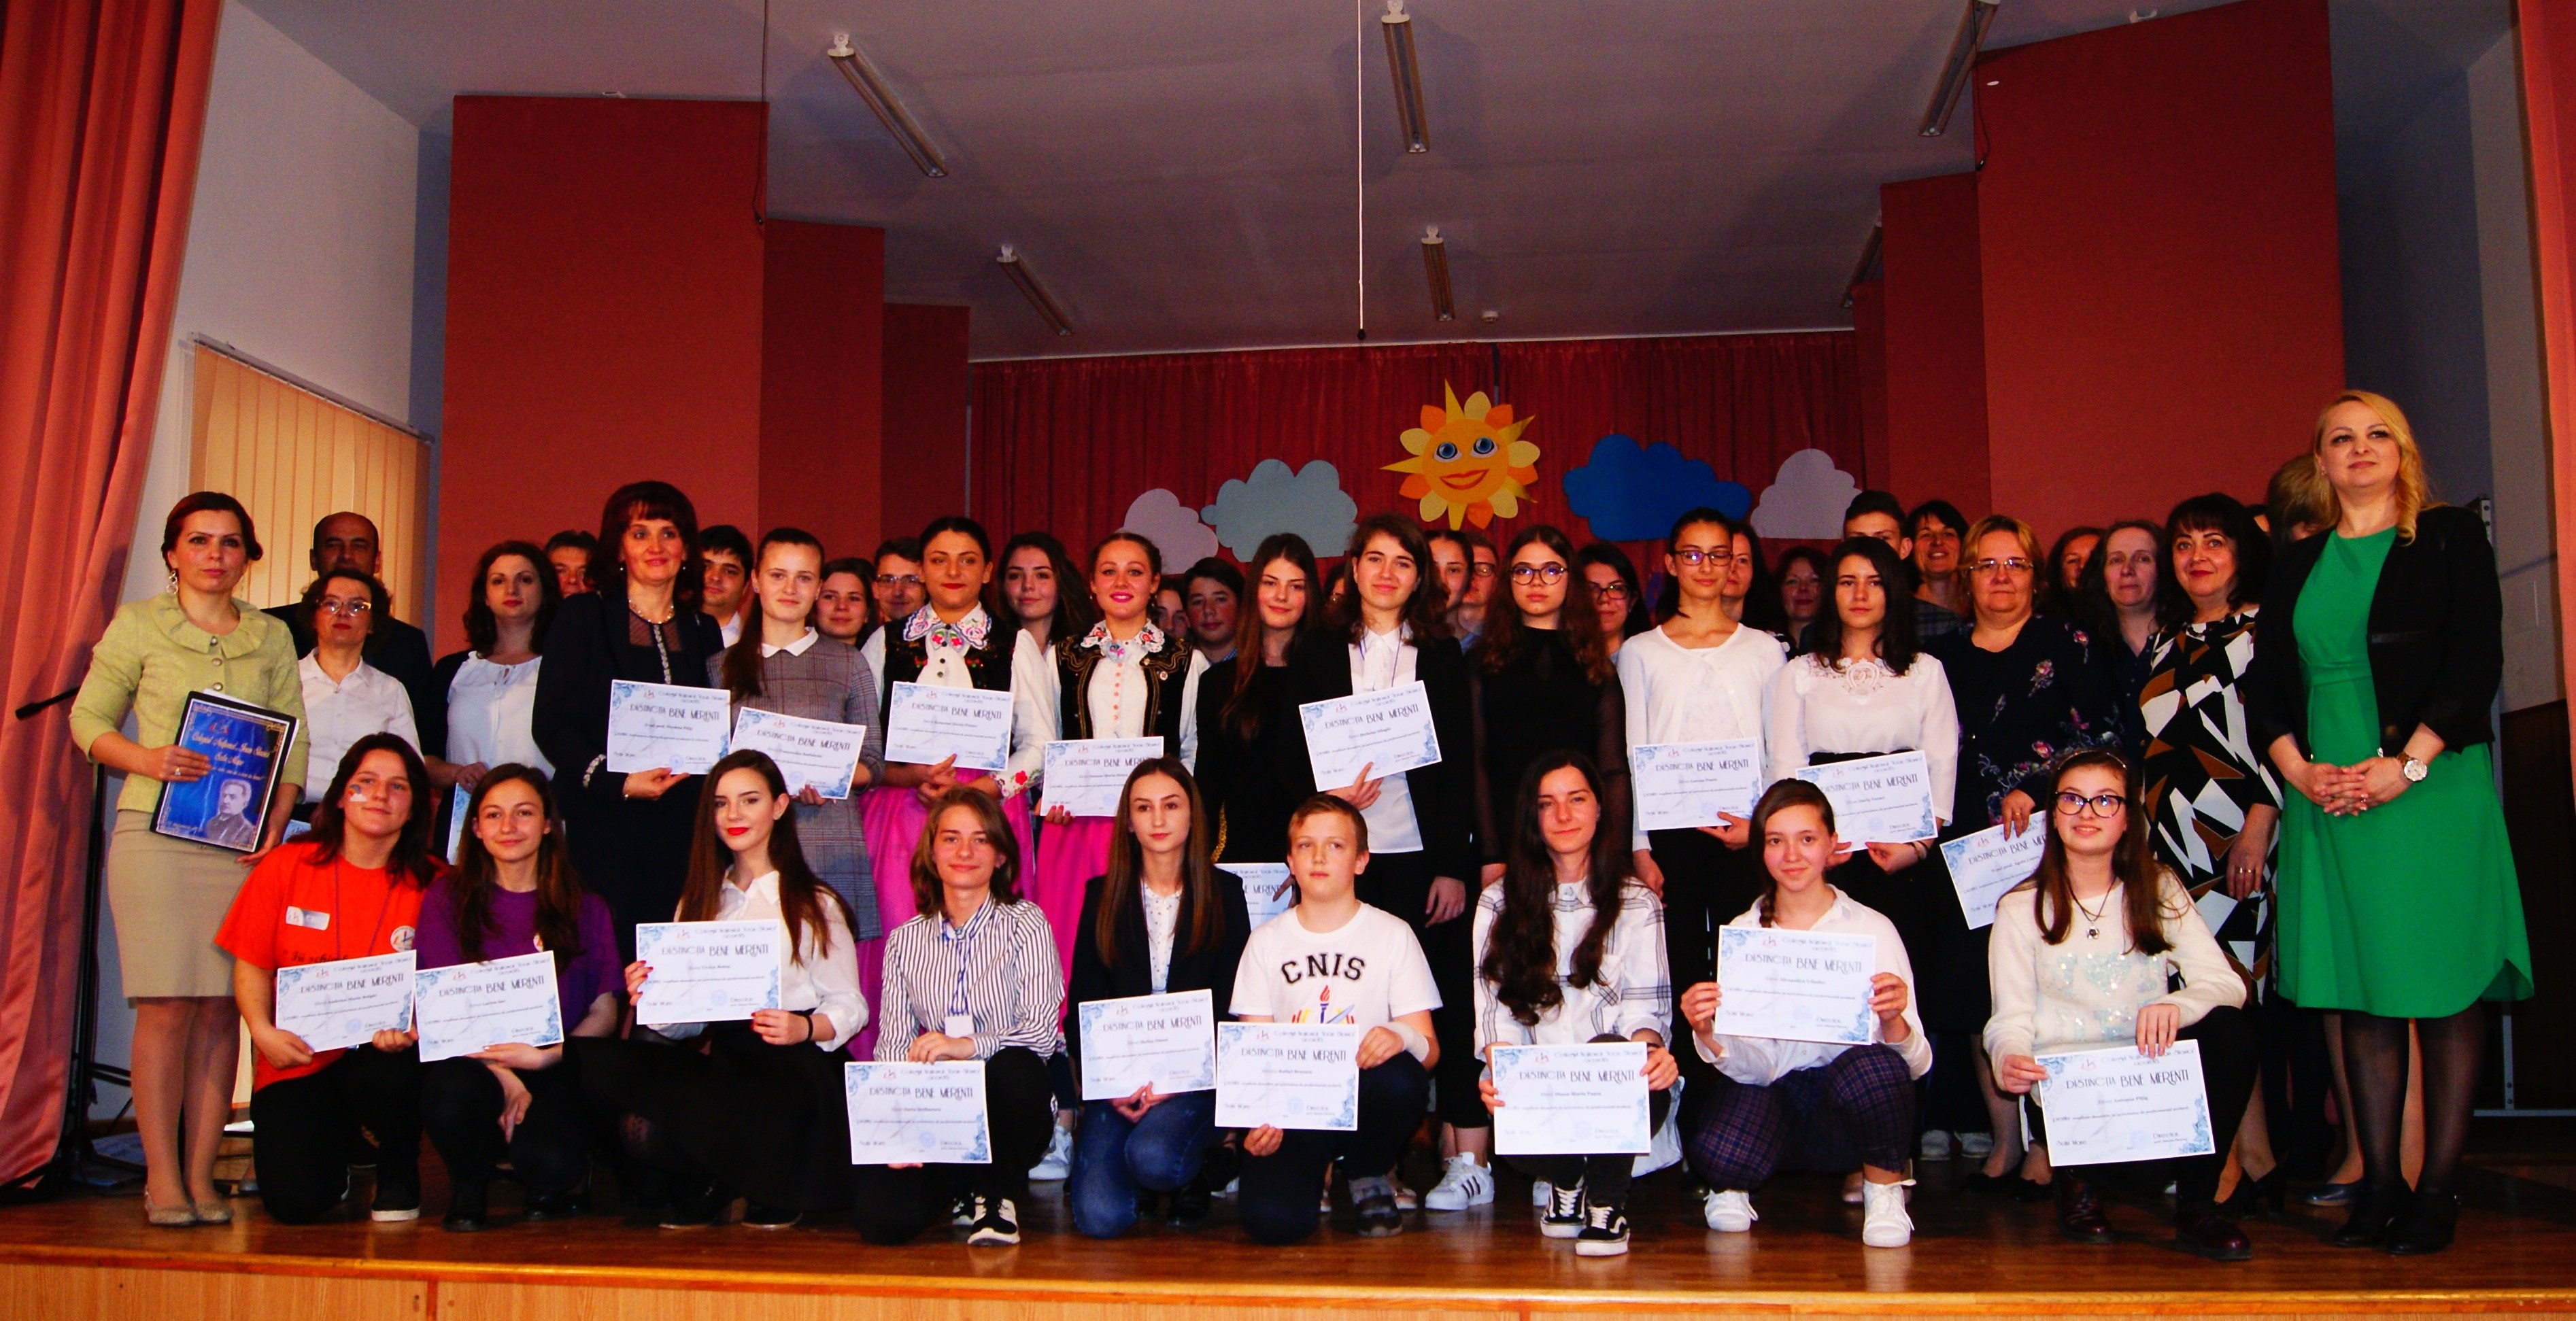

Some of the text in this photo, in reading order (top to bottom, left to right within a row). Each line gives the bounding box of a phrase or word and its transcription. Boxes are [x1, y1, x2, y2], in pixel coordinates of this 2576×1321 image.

[669, 708, 685, 718] BENE
[690, 710, 719, 722] MERENTI
[952, 706, 968, 717] BENE
[973, 710, 1002, 721] MERENTI
[1366, 713, 1384, 724] BENE
[1389, 704, 1419, 718] MERENTI
[798, 736, 815, 747] BENE
[821, 740, 850, 751] MERENTI
[1104, 758, 1119, 767] BENE
[1697, 762, 1714, 771] BENE
[1719, 759, 1748, 771] MERENTI
[1863, 780, 1881, 791] BENE
[1887, 774, 1918, 787] MERENTI
[2010, 840, 2029, 854] BENE
[709, 946, 728, 957] BENE
[735, 944, 768, 957] MERENTI
[1281, 953, 1365, 984] CNIS
[1797, 957, 1818, 970] BENE
[1825, 960, 1861, 975] MERENTI
[347, 979, 367, 991] BENE
[372, 974, 403, 986] MERENTI
[486, 982, 506, 993] BENE
[511, 976, 544, 990] MERENTI
[1147, 1020, 1165, 1031] BENE
[1171, 1015, 1202, 1029] MERENTI
[1287, 1050, 1306, 1061] BENE
[1313, 1051, 1346, 1064] MERENTI
[1570, 1071, 1591, 1082] BENE
[1598, 1070, 1634, 1084] MERENTI
[2121, 1075, 2143, 1088] BENE
[2150, 1069, 2189, 1086] MERENTI
[915, 1088, 934, 1099] BENE
[940, 1088, 973, 1101] MERENTI
